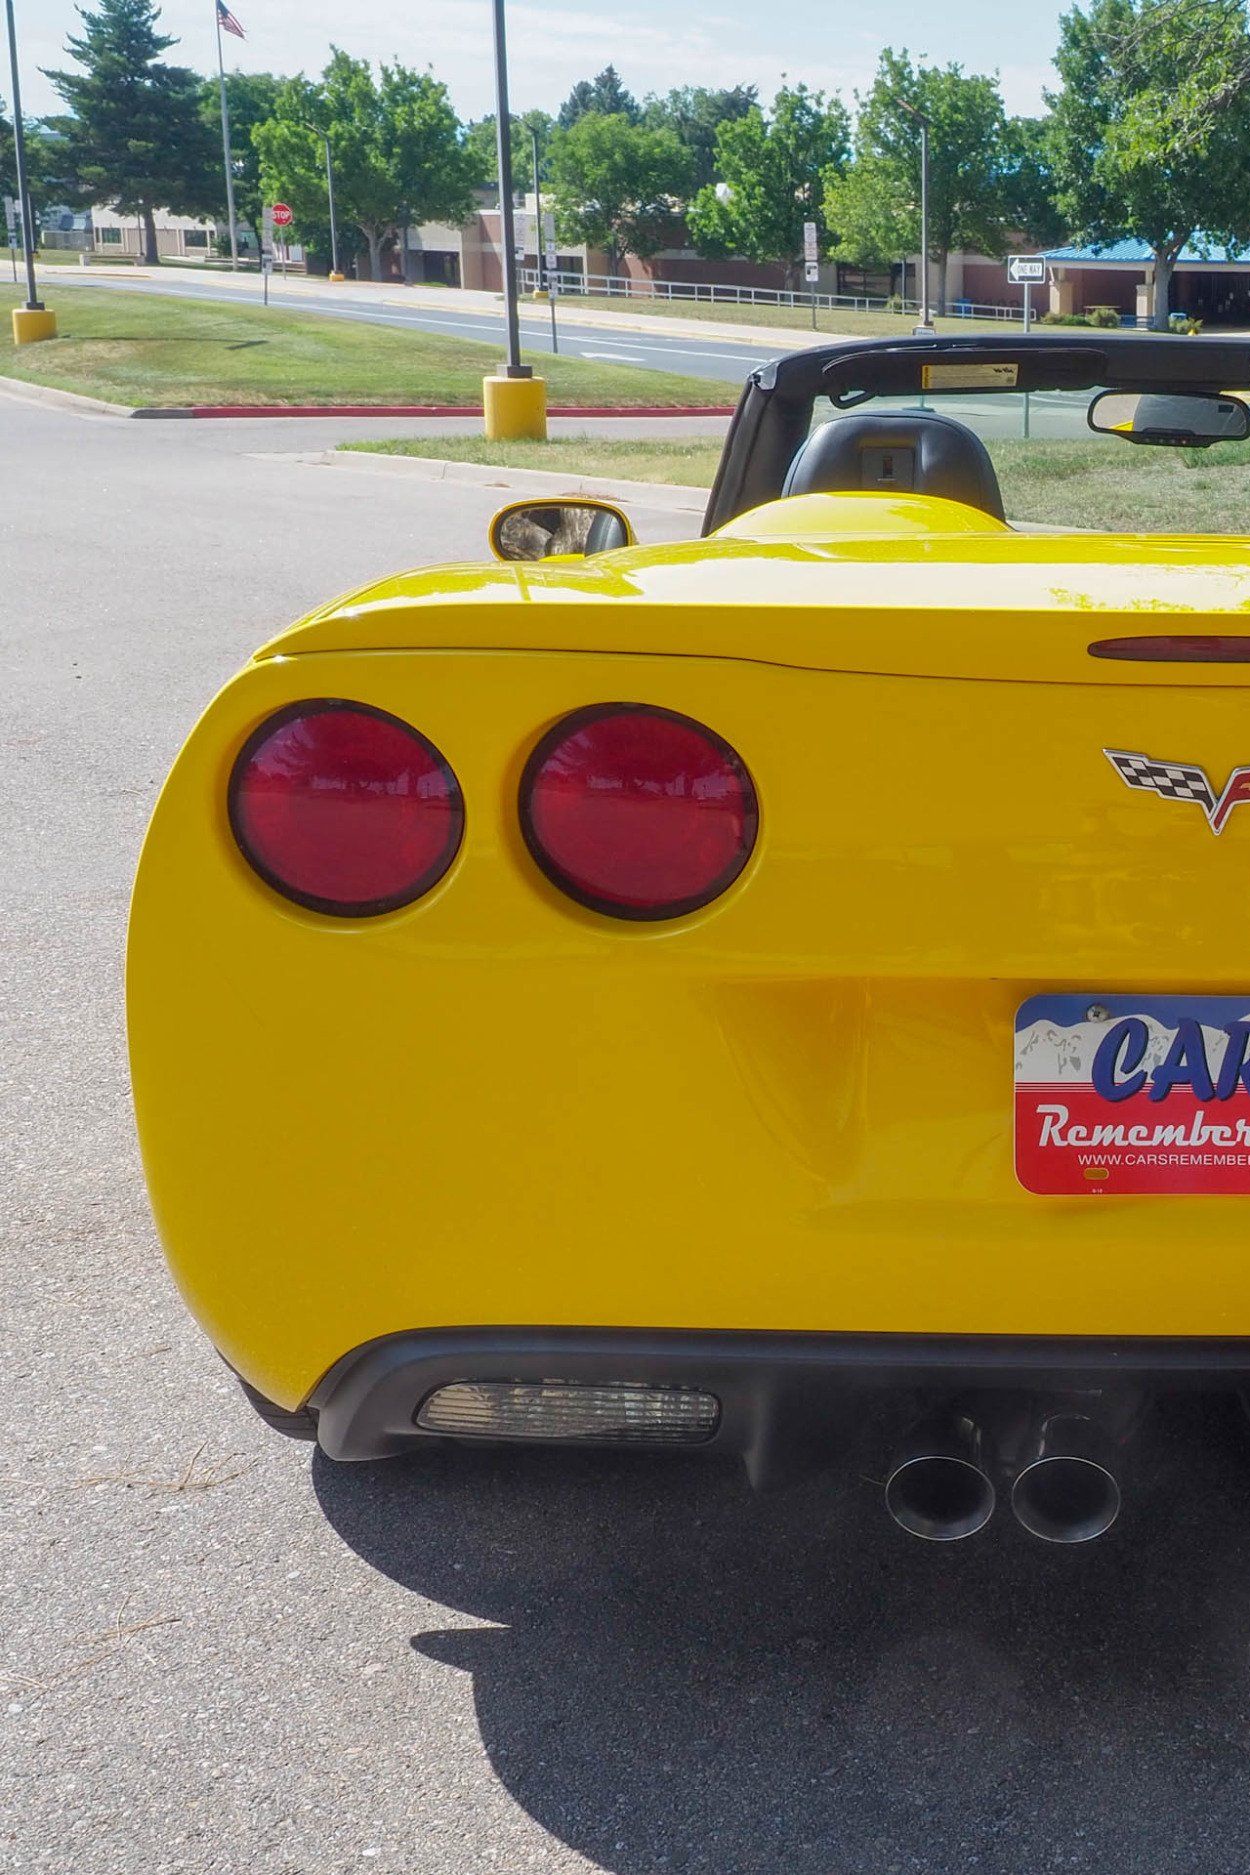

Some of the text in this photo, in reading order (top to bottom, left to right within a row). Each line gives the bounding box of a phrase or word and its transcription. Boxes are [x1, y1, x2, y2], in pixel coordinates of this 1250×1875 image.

[272, 210, 290, 220] STOP
[1017, 263, 1041, 275] ONE WAY
